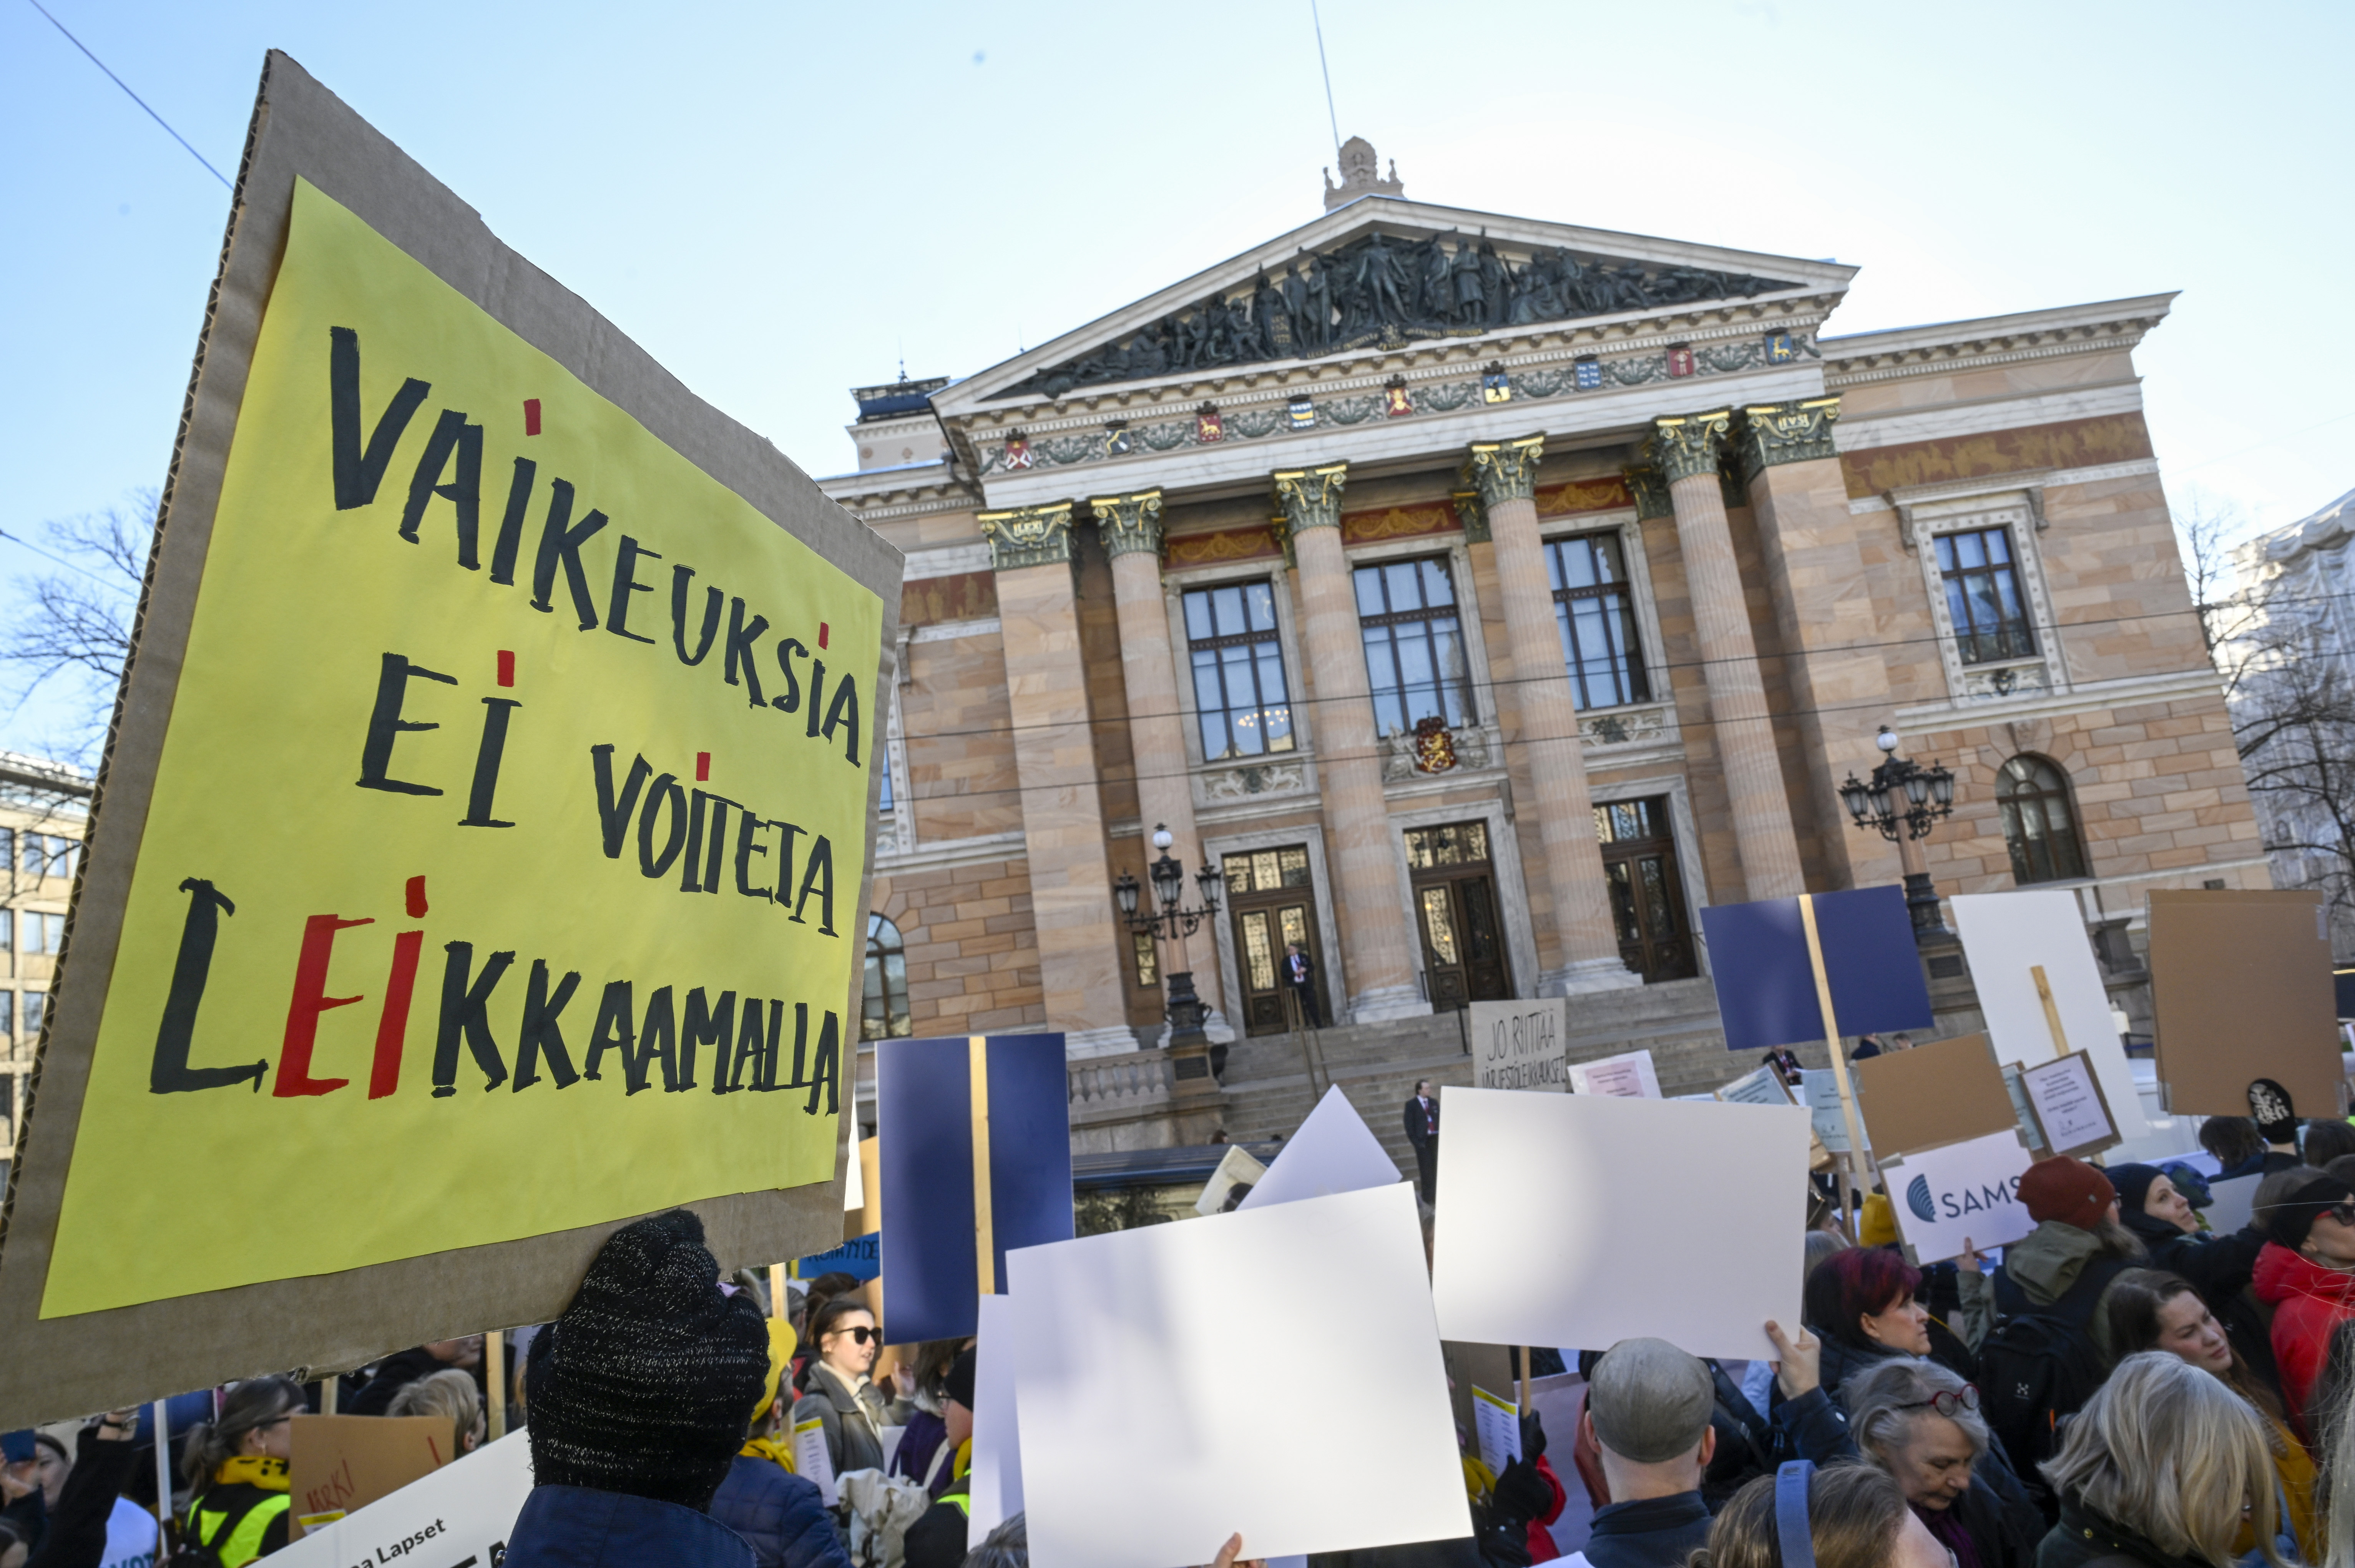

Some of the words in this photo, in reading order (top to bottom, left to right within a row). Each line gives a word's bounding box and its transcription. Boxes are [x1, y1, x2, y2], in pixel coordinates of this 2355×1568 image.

[1017, 520, 1038, 533] LEX
[1487, 1019, 1507, 1061] JO
[1512, 1008, 1556, 1056] RIITTÄÄ
[376, 1518, 446, 1564] Lapset
